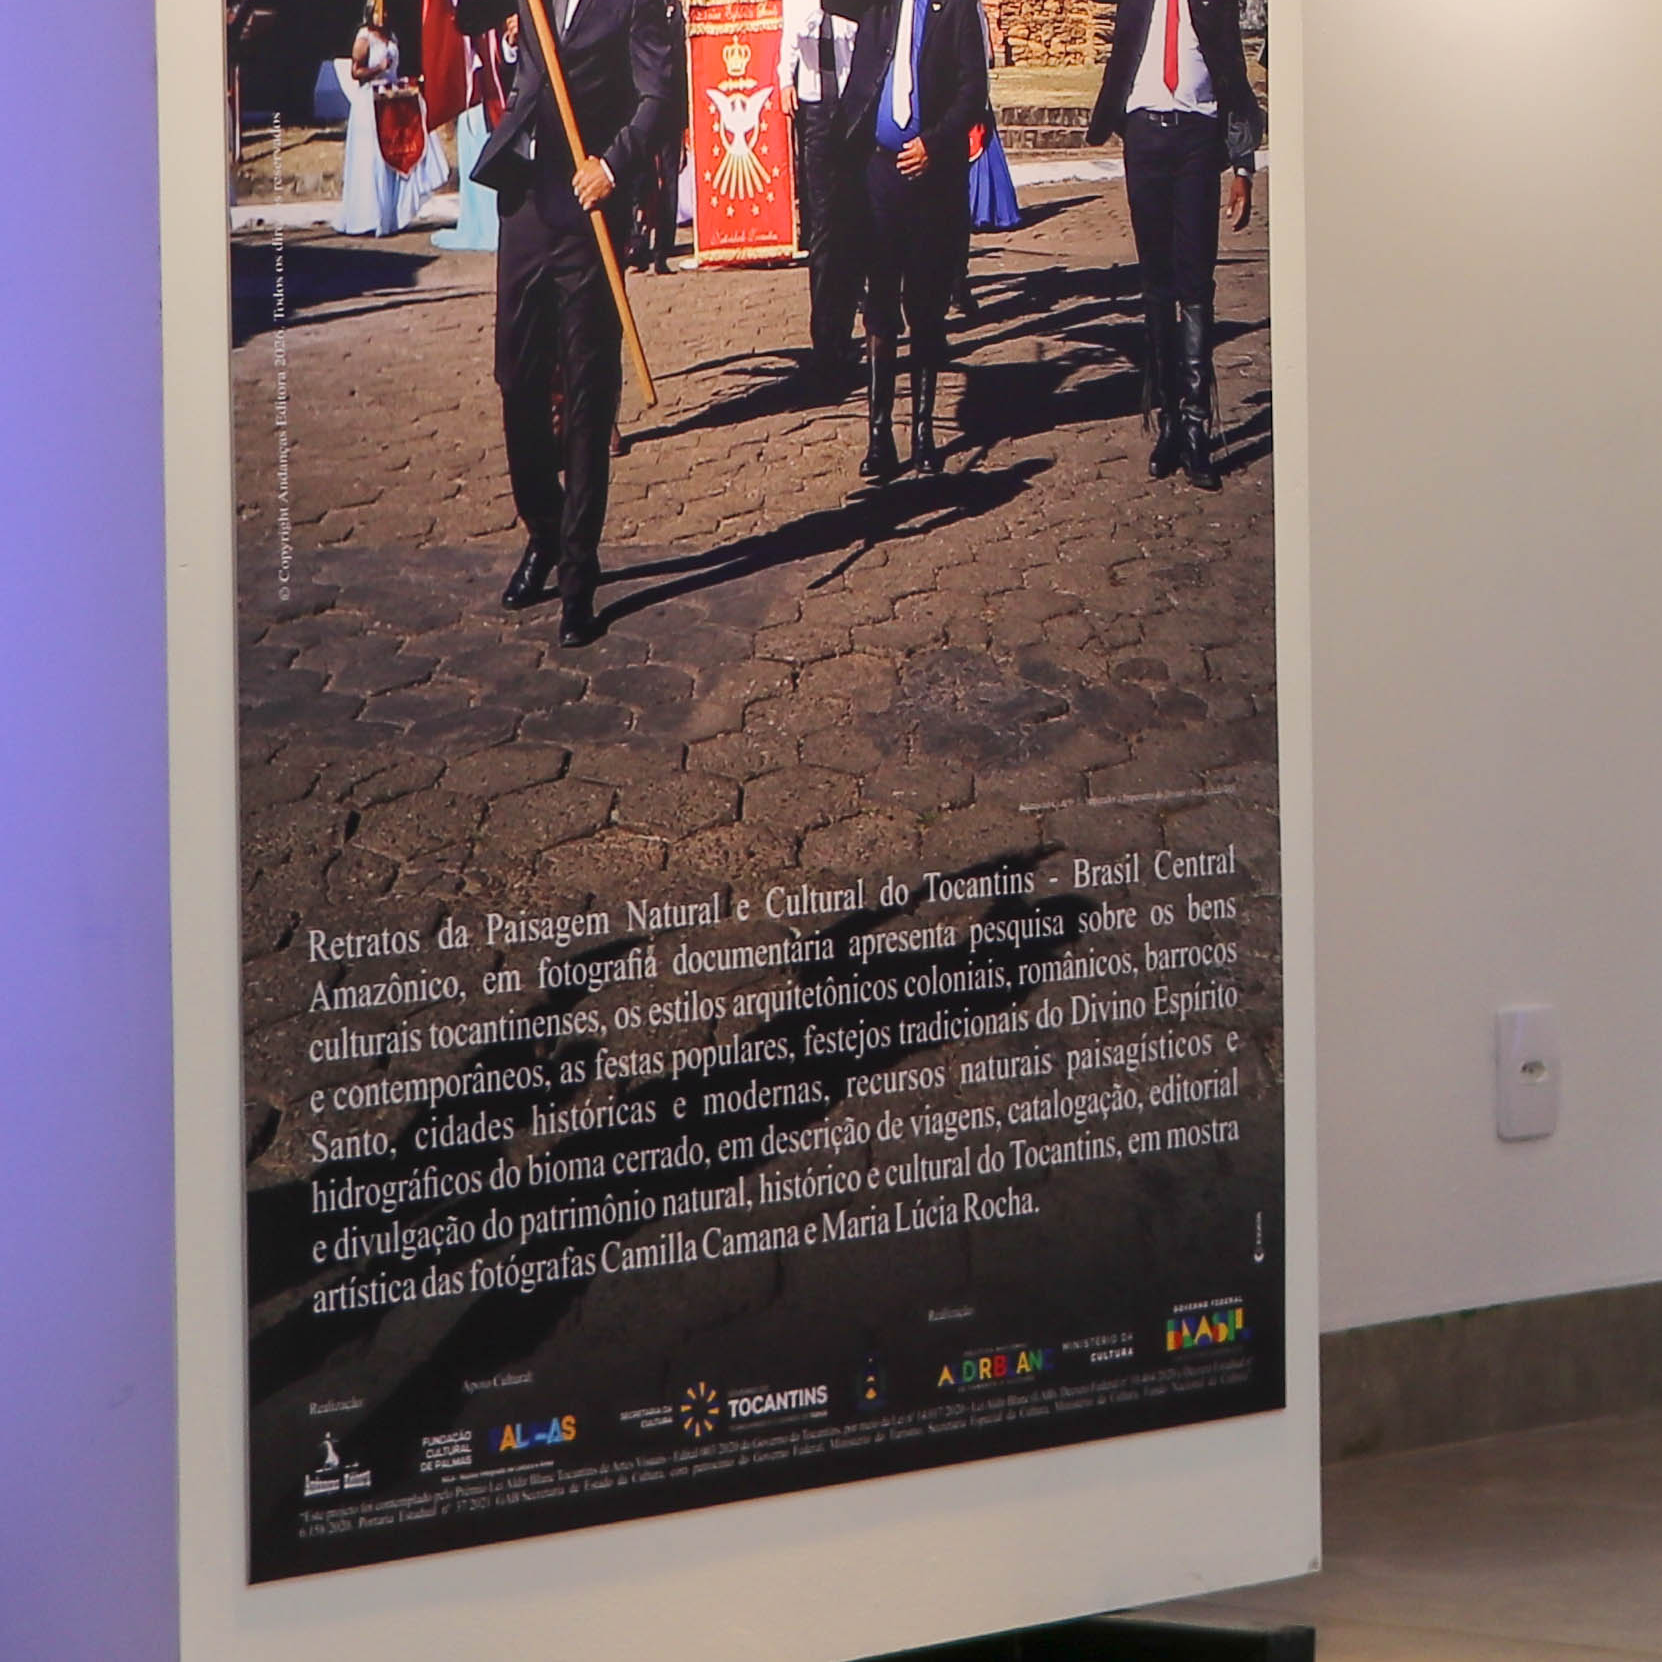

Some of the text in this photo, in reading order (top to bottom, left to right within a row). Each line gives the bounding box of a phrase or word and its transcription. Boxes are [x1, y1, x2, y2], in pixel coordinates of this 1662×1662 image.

[269, 111, 283, 190] reservados
[273, 276, 285, 320] Todos
[274, 254, 285, 272] os
[274, 371, 288, 426] Editora
[276, 430, 291, 502] Andanças
[277, 506, 293, 581] Copyright
[308, 925, 421, 963] Retratos
[437, 915, 474, 950] da
[485, 909, 610, 948] Paisagem
[626, 891, 721, 933] Natural
[737, 901, 751, 922] e
[765, 879, 868, 920] Cultural
[879, 875, 910, 907] do
[924, 864, 1035, 903] Tocantins
[1073, 852, 1140, 889] Brasil
[1154, 843, 1236, 881] Central
[308, 892, 1238, 1014] Amazônico, em fotografia documentária apresenta pesquisa sobre os bens
[308, 933, 1238, 1063] culturais tocantinenses, os estilos arquitetônicos coloniais, românicos, barrocos
[309, 977, 1238, 1117] e contemporâneos, as festas populares, festejos tradicionais do Divino Espírito
[311, 1030, 1239, 1164] Santo, cidades históricas e modernas, recursos naturais paisagísticos e
[311, 1066, 1239, 1214] hidrográficos do bioma cerrado, em descrição de viagens, catalogação, editorial
[312, 1118, 1240, 1264] e divulgação do patrimônio natural, histórico e cultural do Tocantins, em mostra
[312, 1185, 1040, 1314] artística das fotógrafas Camilla Camana e Maria Lúcia Rocha.
[727, 1384, 829, 1419] TOCANTINS
